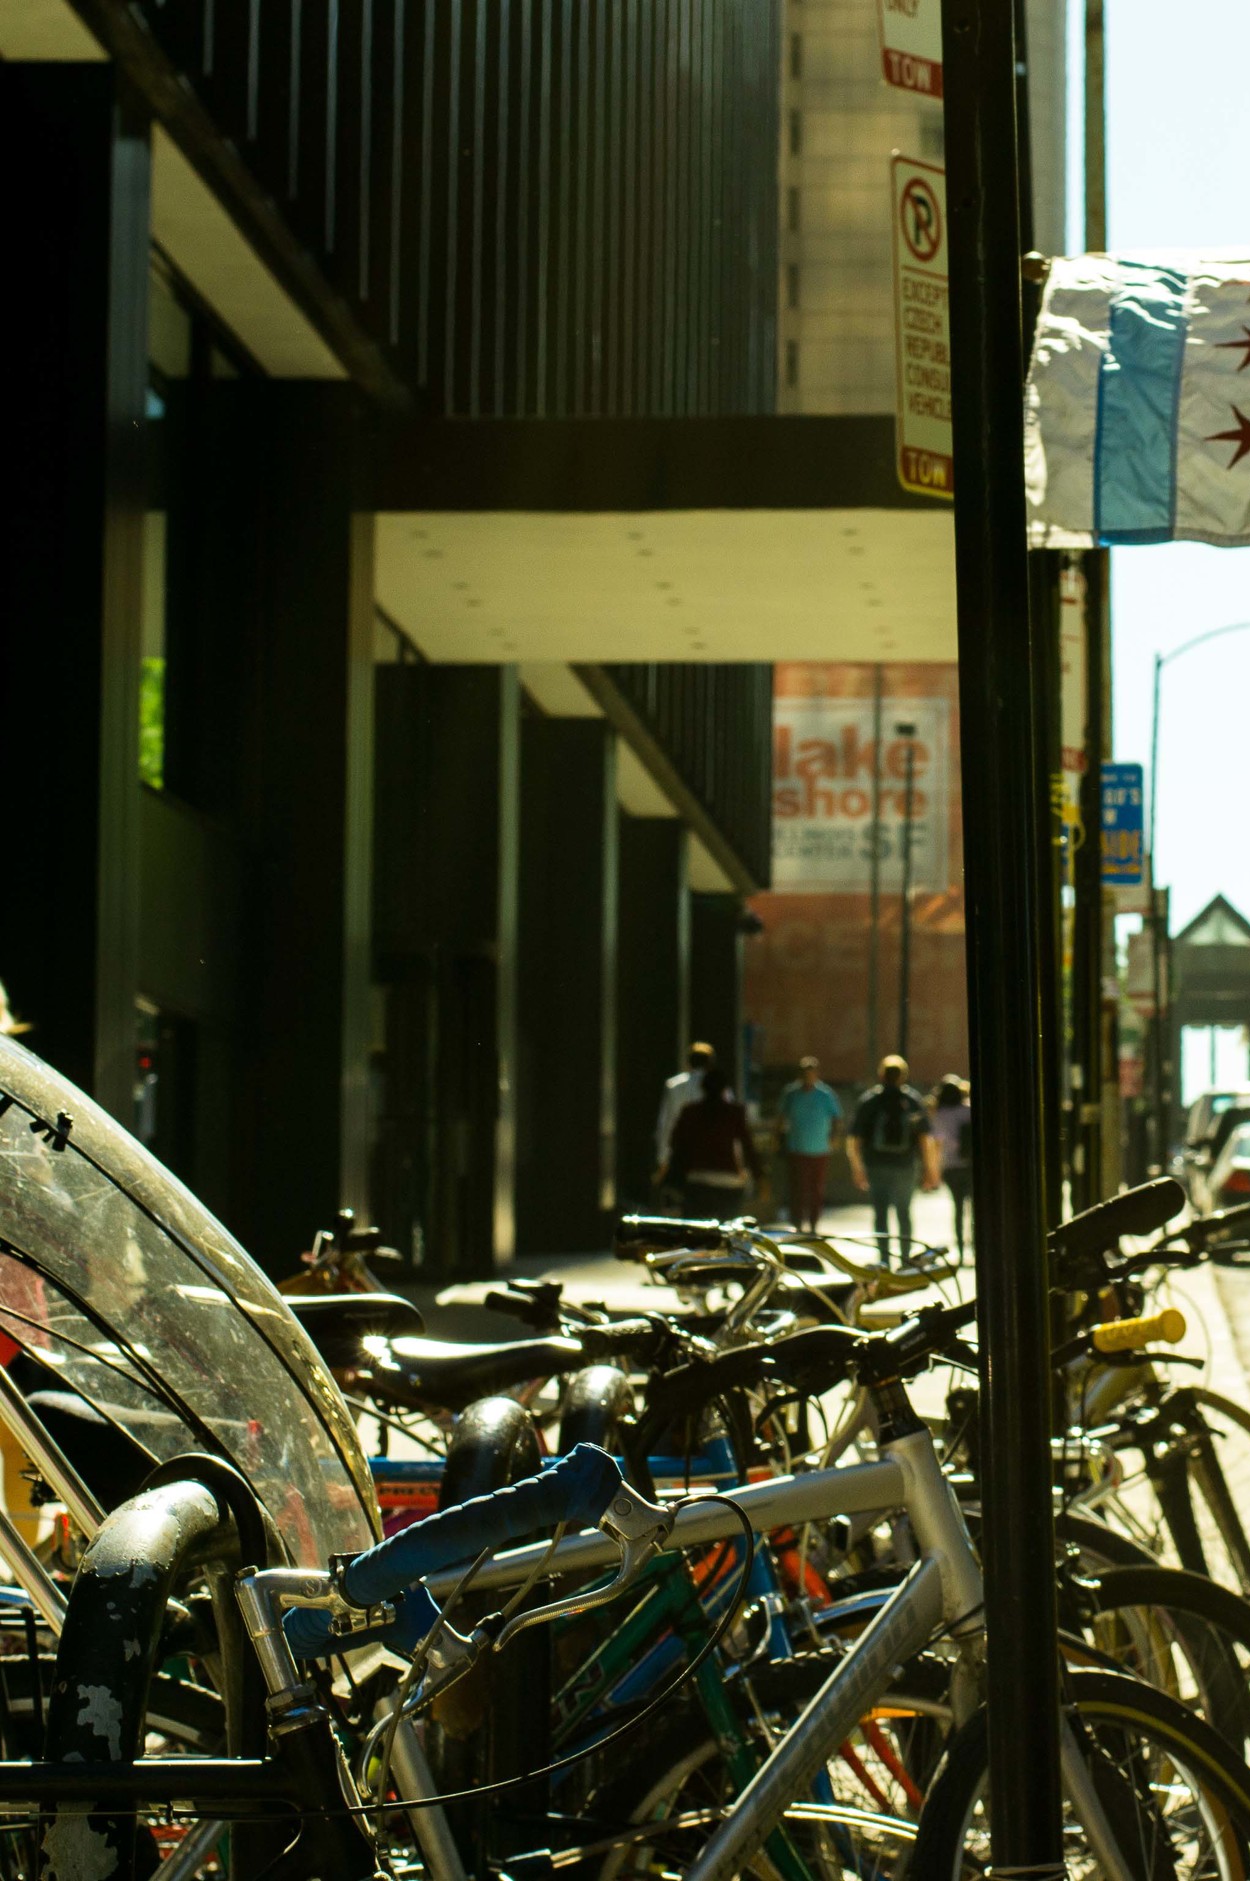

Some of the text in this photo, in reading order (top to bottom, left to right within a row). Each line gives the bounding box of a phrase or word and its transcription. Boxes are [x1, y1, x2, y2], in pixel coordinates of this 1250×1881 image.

[889, 52, 931, 92] TOW
[907, 451, 947, 488] TOW
[774, 724, 929, 779] lake
[774, 770, 928, 821] shore
